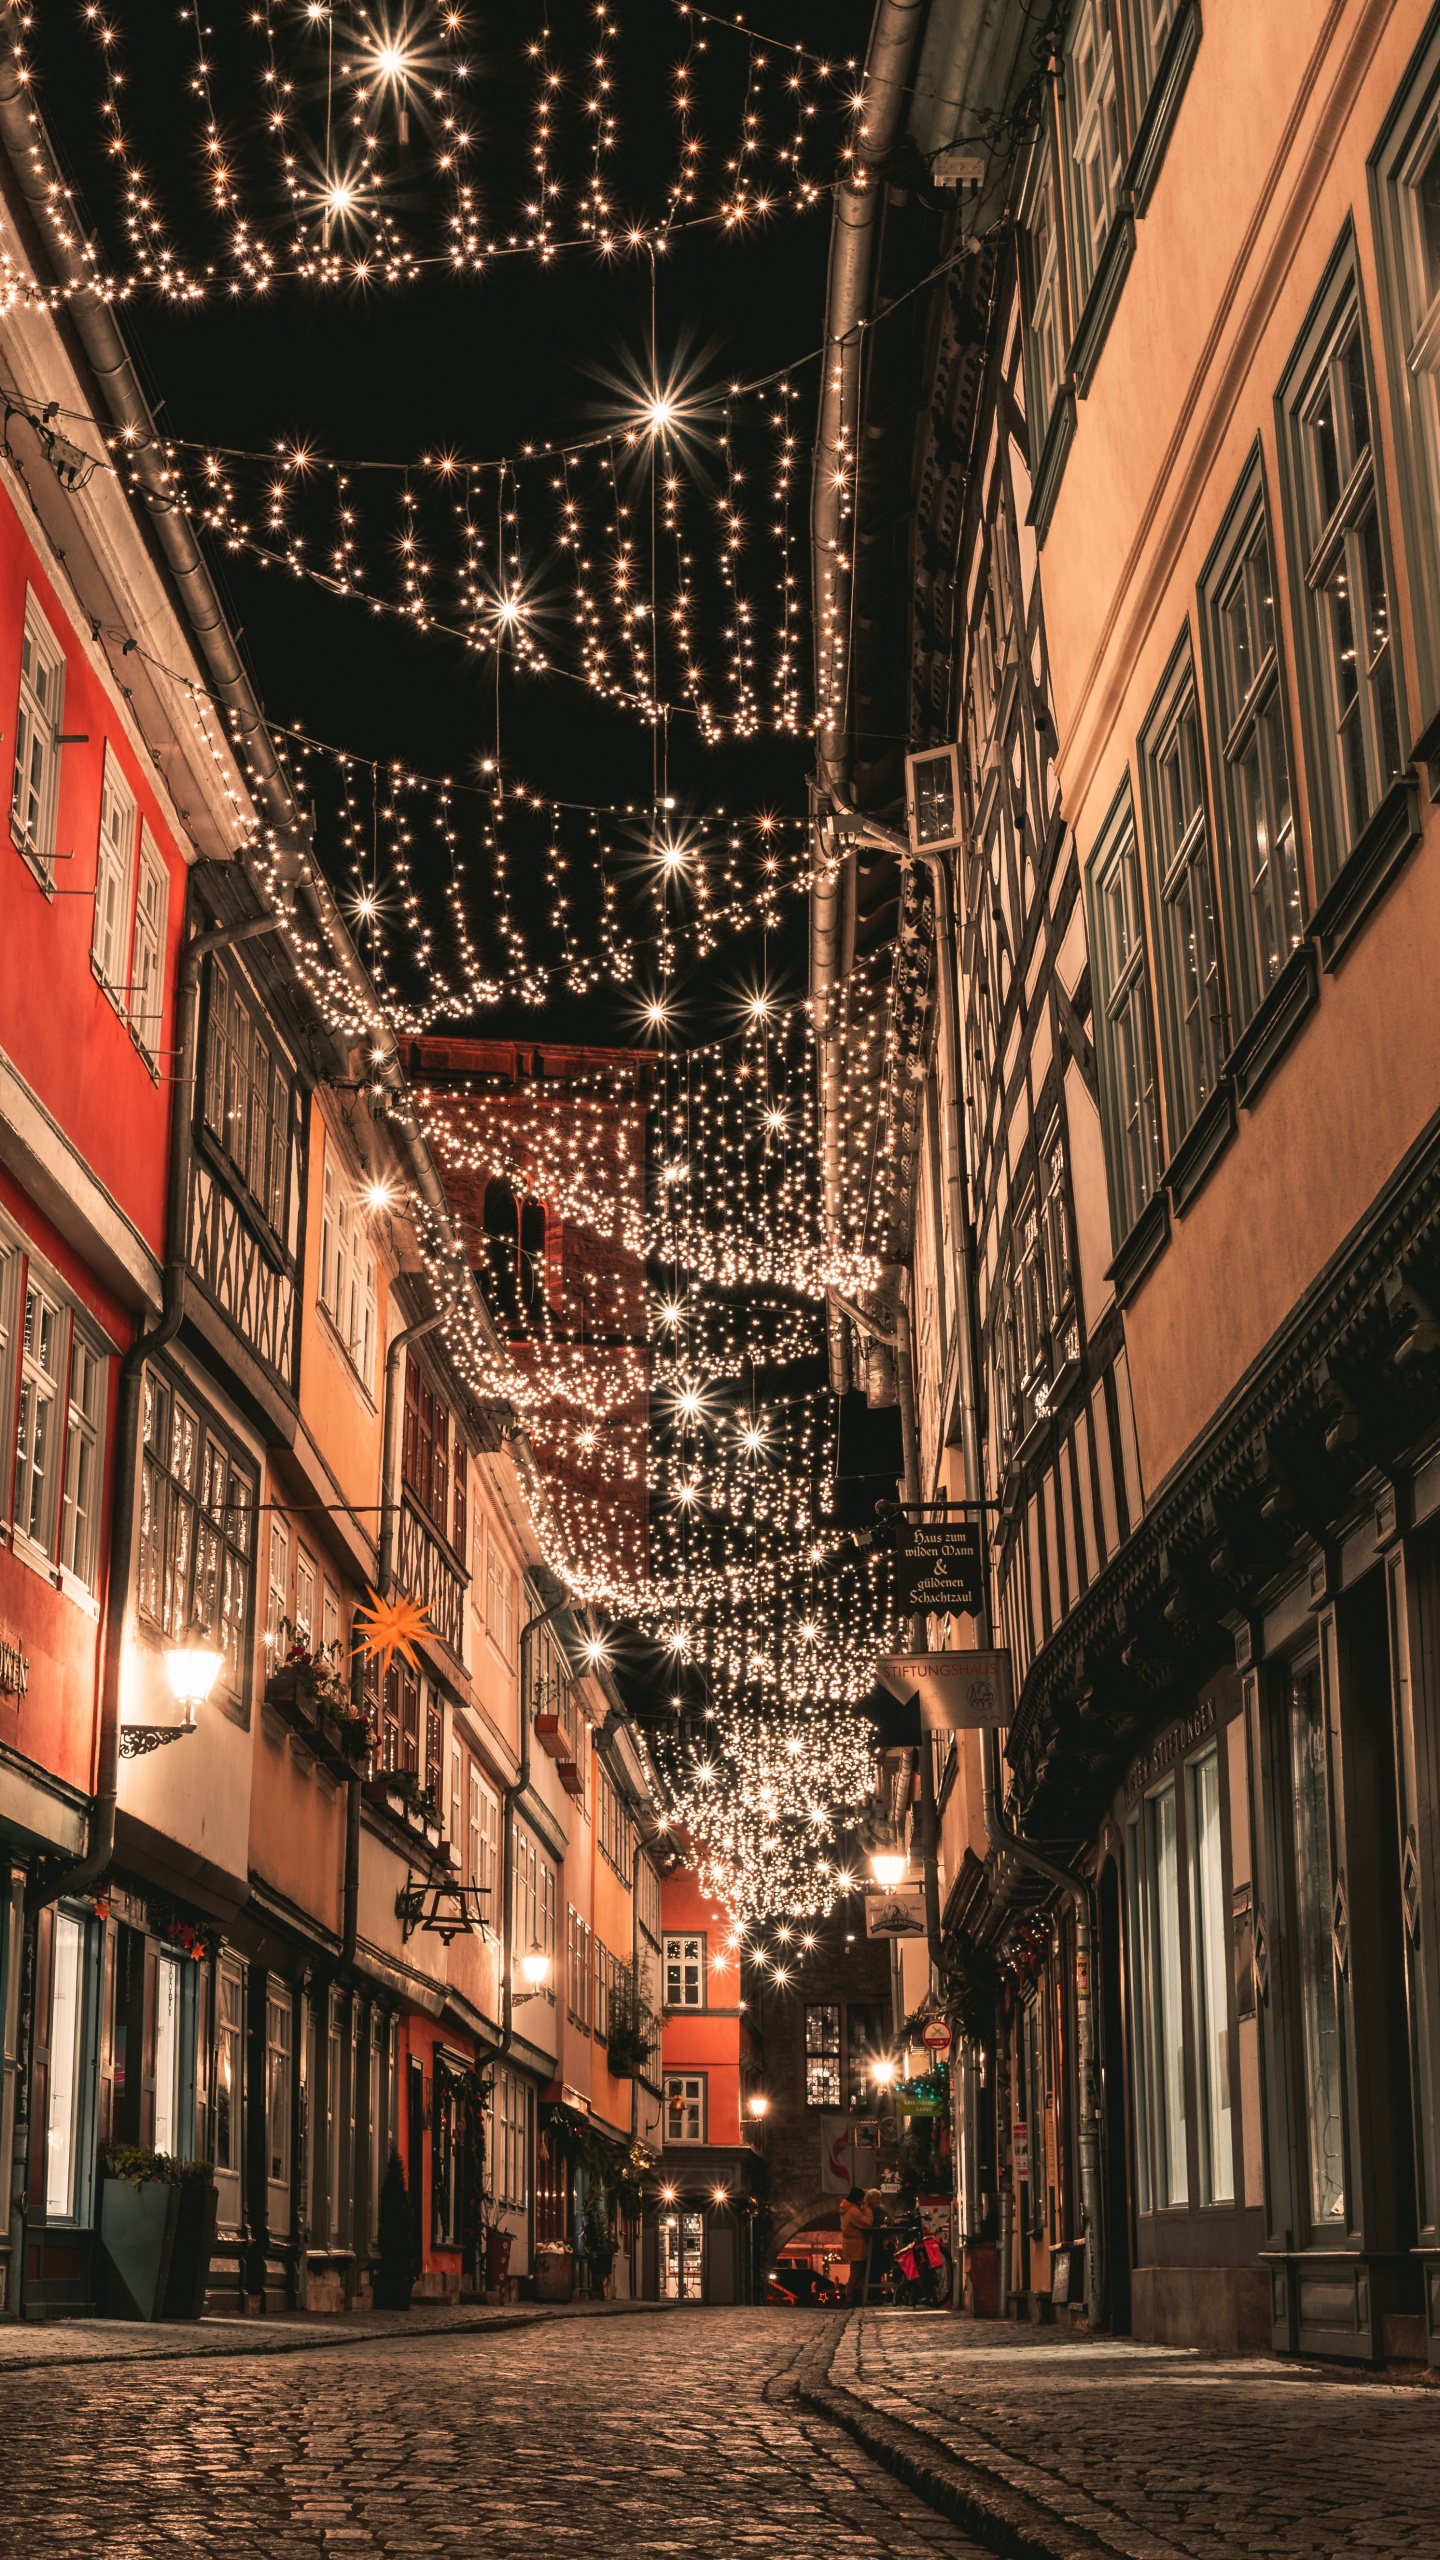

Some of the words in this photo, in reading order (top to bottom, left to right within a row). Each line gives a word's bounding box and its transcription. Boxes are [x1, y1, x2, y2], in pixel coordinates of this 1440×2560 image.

[914, 1529, 942, 1545] Haus
[945, 1534, 966, 1542] zum
[905, 1546, 938, 1556] wilden
[941, 1545, 974, 1556] Mann
[933, 1558, 948, 1575] &
[917, 1577, 964, 1591] güldenen
[909, 1590, 972, 1604] Schachtzaul
[883, 1662, 997, 1679] STIFTUNGSHAUS
[1153, 1698, 1217, 1772] STIFTUNGEN
[872, 1919, 922, 1931] MUNDLANDUNG
